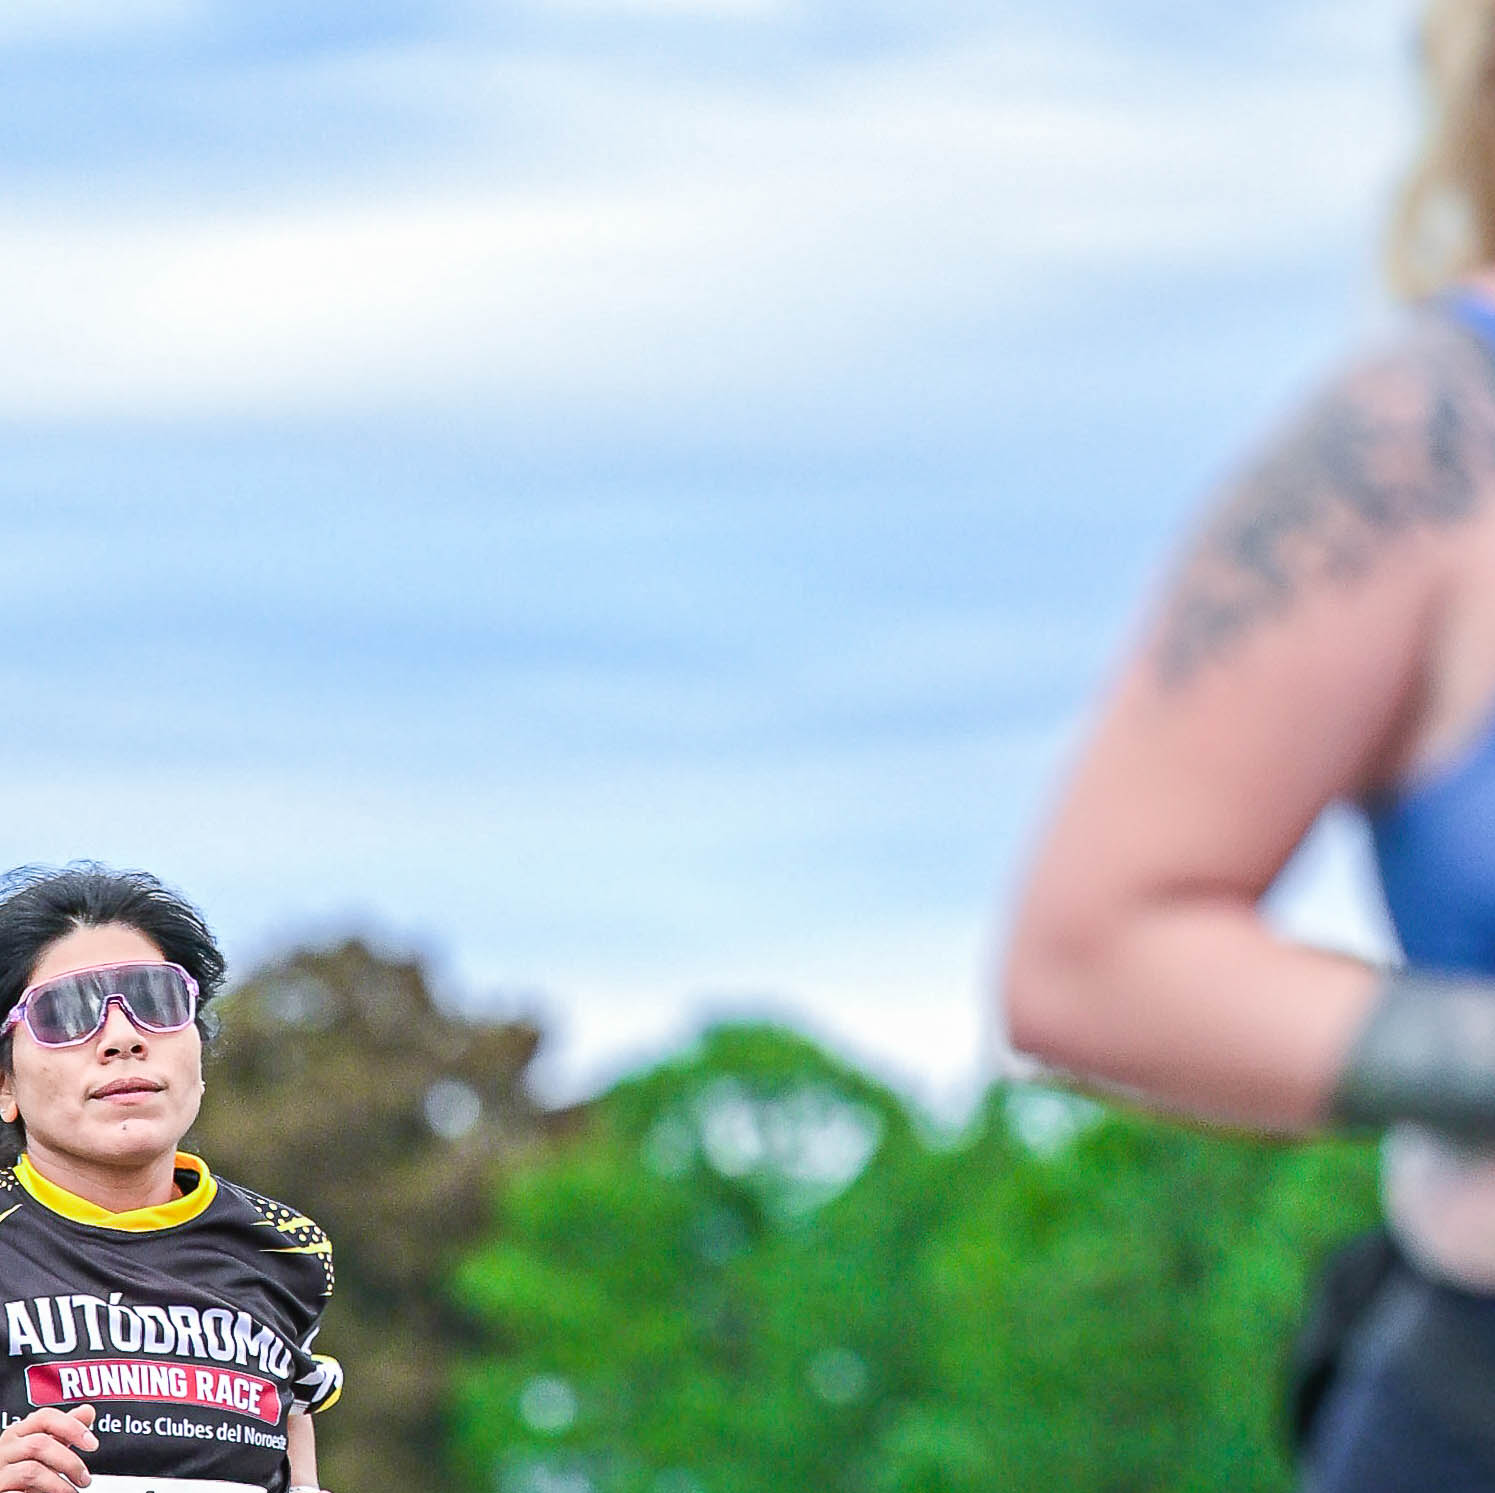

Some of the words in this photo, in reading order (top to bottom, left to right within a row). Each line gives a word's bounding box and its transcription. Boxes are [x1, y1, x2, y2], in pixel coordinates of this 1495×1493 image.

[4, 1292, 292, 1380] AUTÓDROMO
[59, 1364, 188, 1400] RUNNING
[195, 1369, 264, 1415] RACE
[98, 1413, 122, 1433] de
[125, 1414, 151, 1435] los
[154, 1417, 213, 1440] Clubes
[217, 1421, 242, 1443] del
